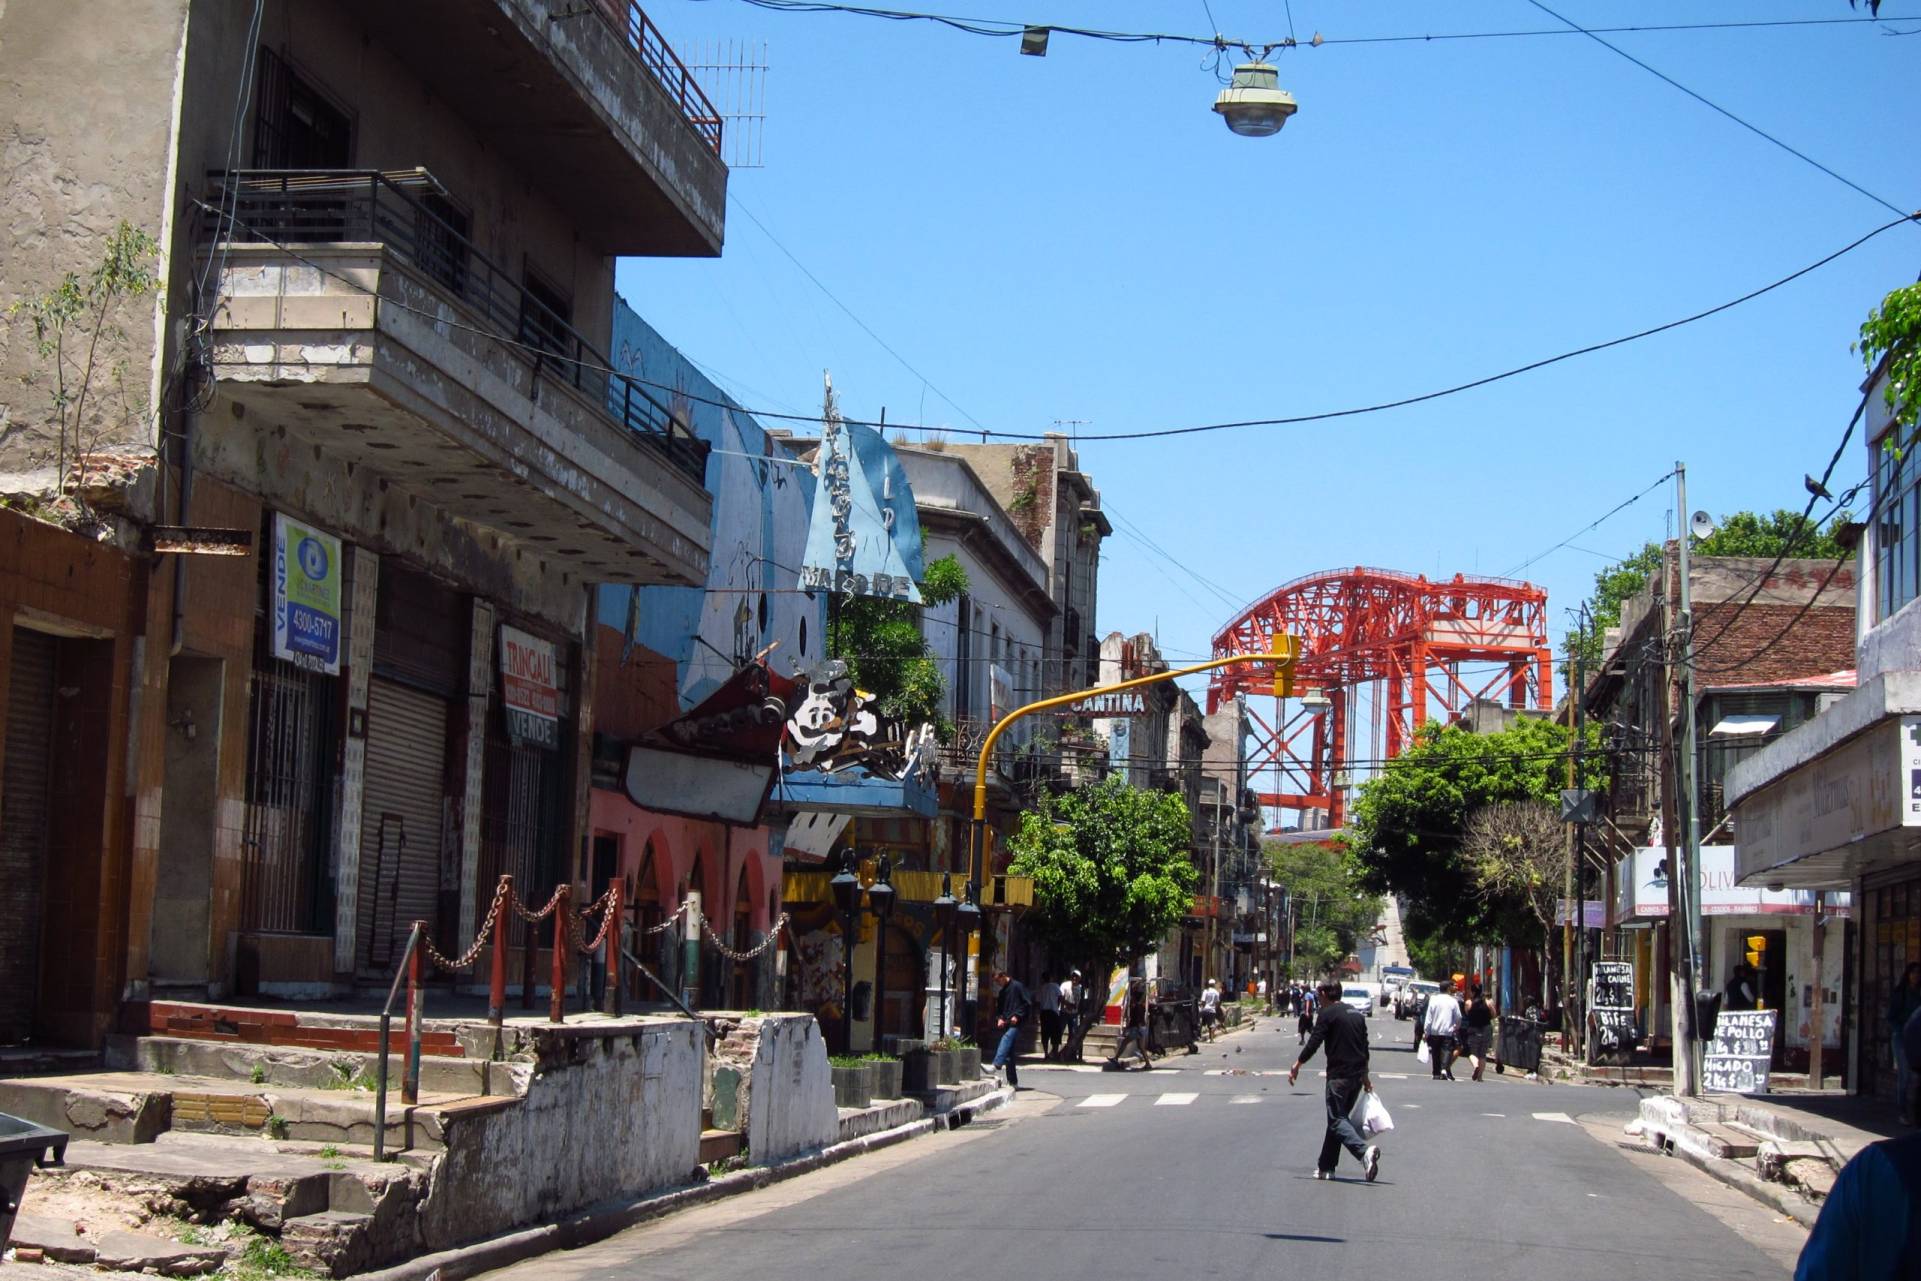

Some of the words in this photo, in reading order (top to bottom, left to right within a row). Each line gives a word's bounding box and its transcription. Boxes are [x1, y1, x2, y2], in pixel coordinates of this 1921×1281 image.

[277, 536, 286, 631] VENDE
[293, 608, 332, 641] 4300-5717
[512, 709, 551, 744] VENDE
[1727, 1026, 1765, 1039] POLLO
